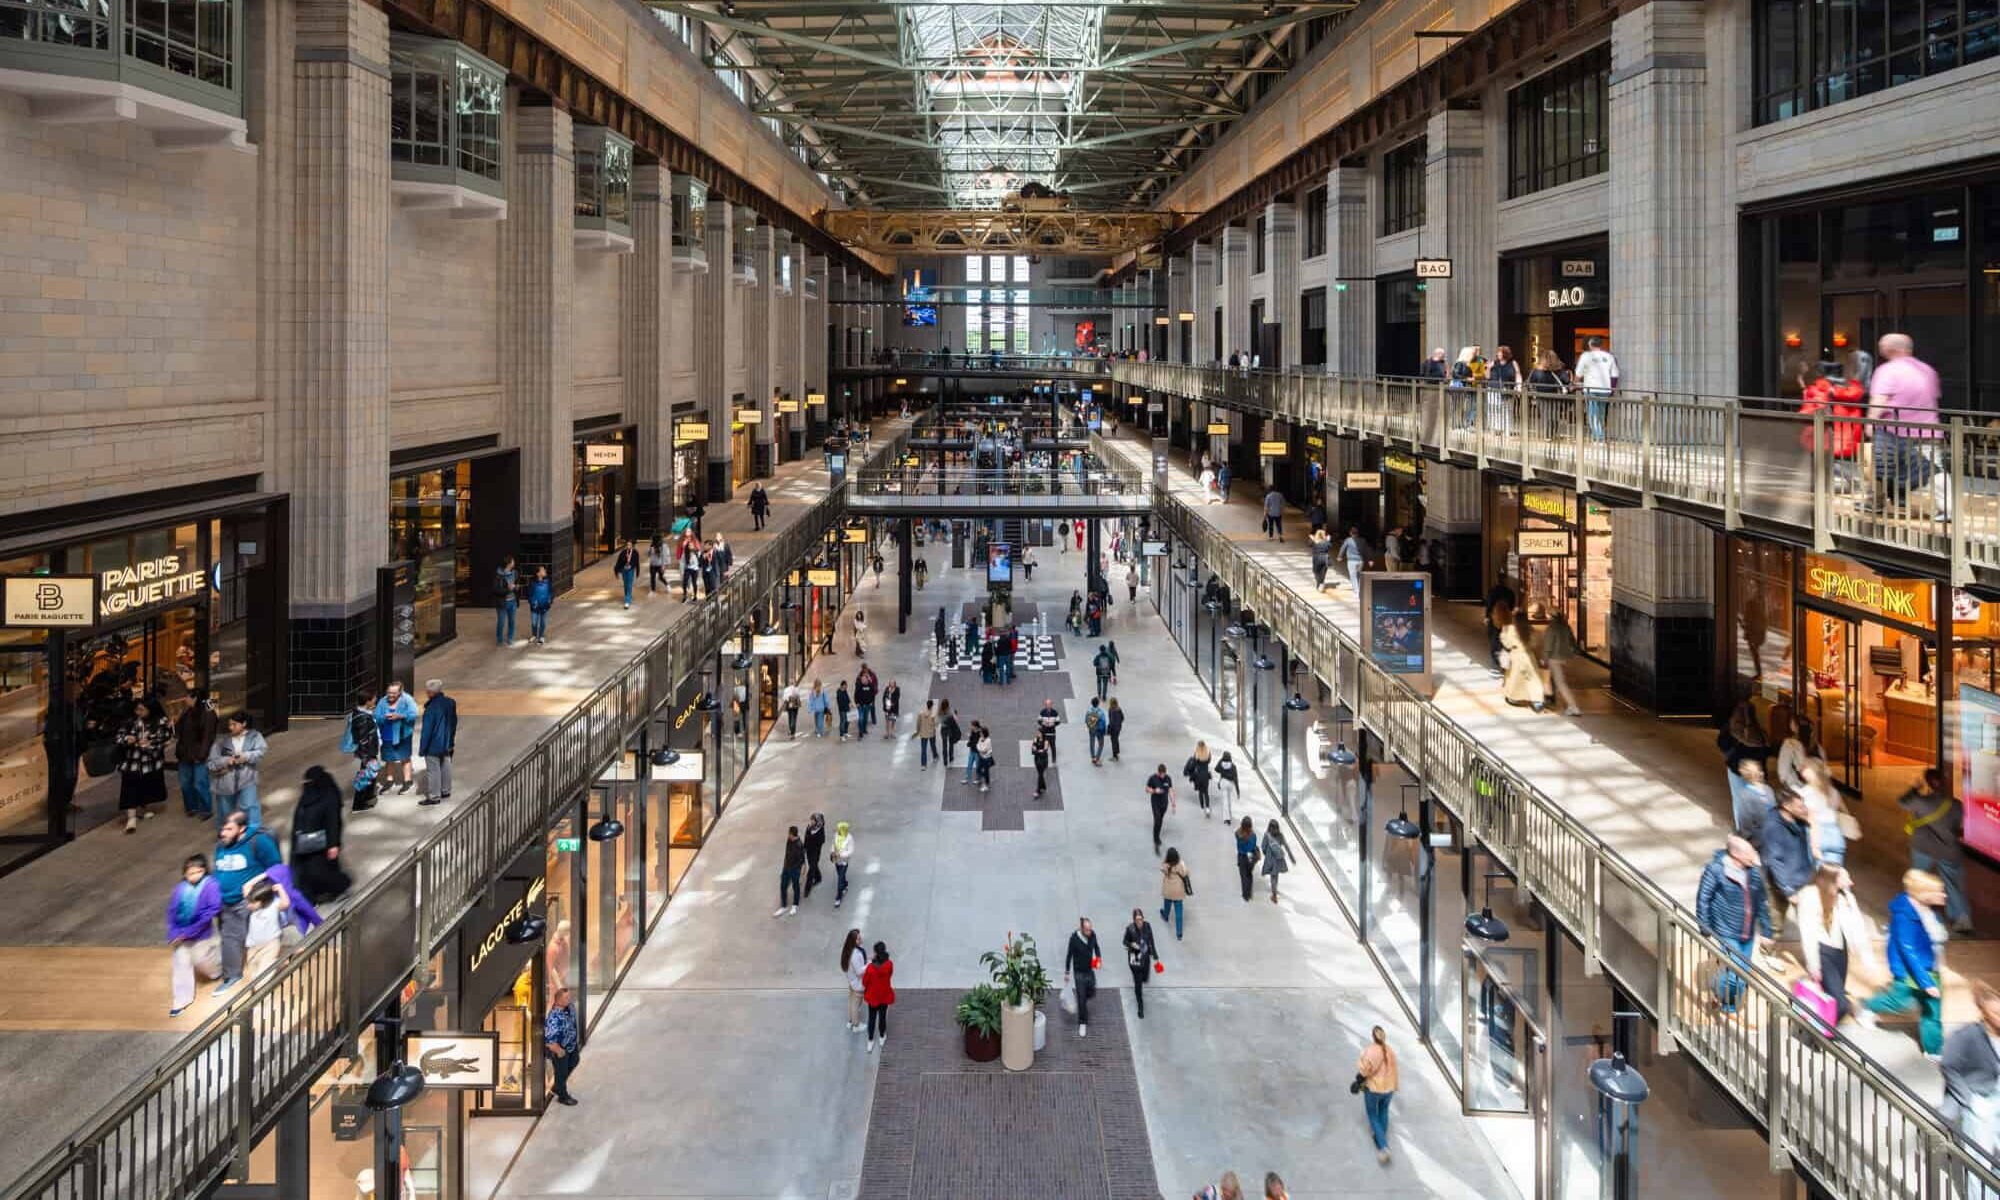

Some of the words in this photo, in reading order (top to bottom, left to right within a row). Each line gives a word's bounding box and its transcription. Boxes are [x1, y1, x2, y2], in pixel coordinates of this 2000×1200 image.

[1420, 264, 1447, 273] BAO
[1548, 286, 1585, 308] BAO
[101, 555, 180, 592] PARIS
